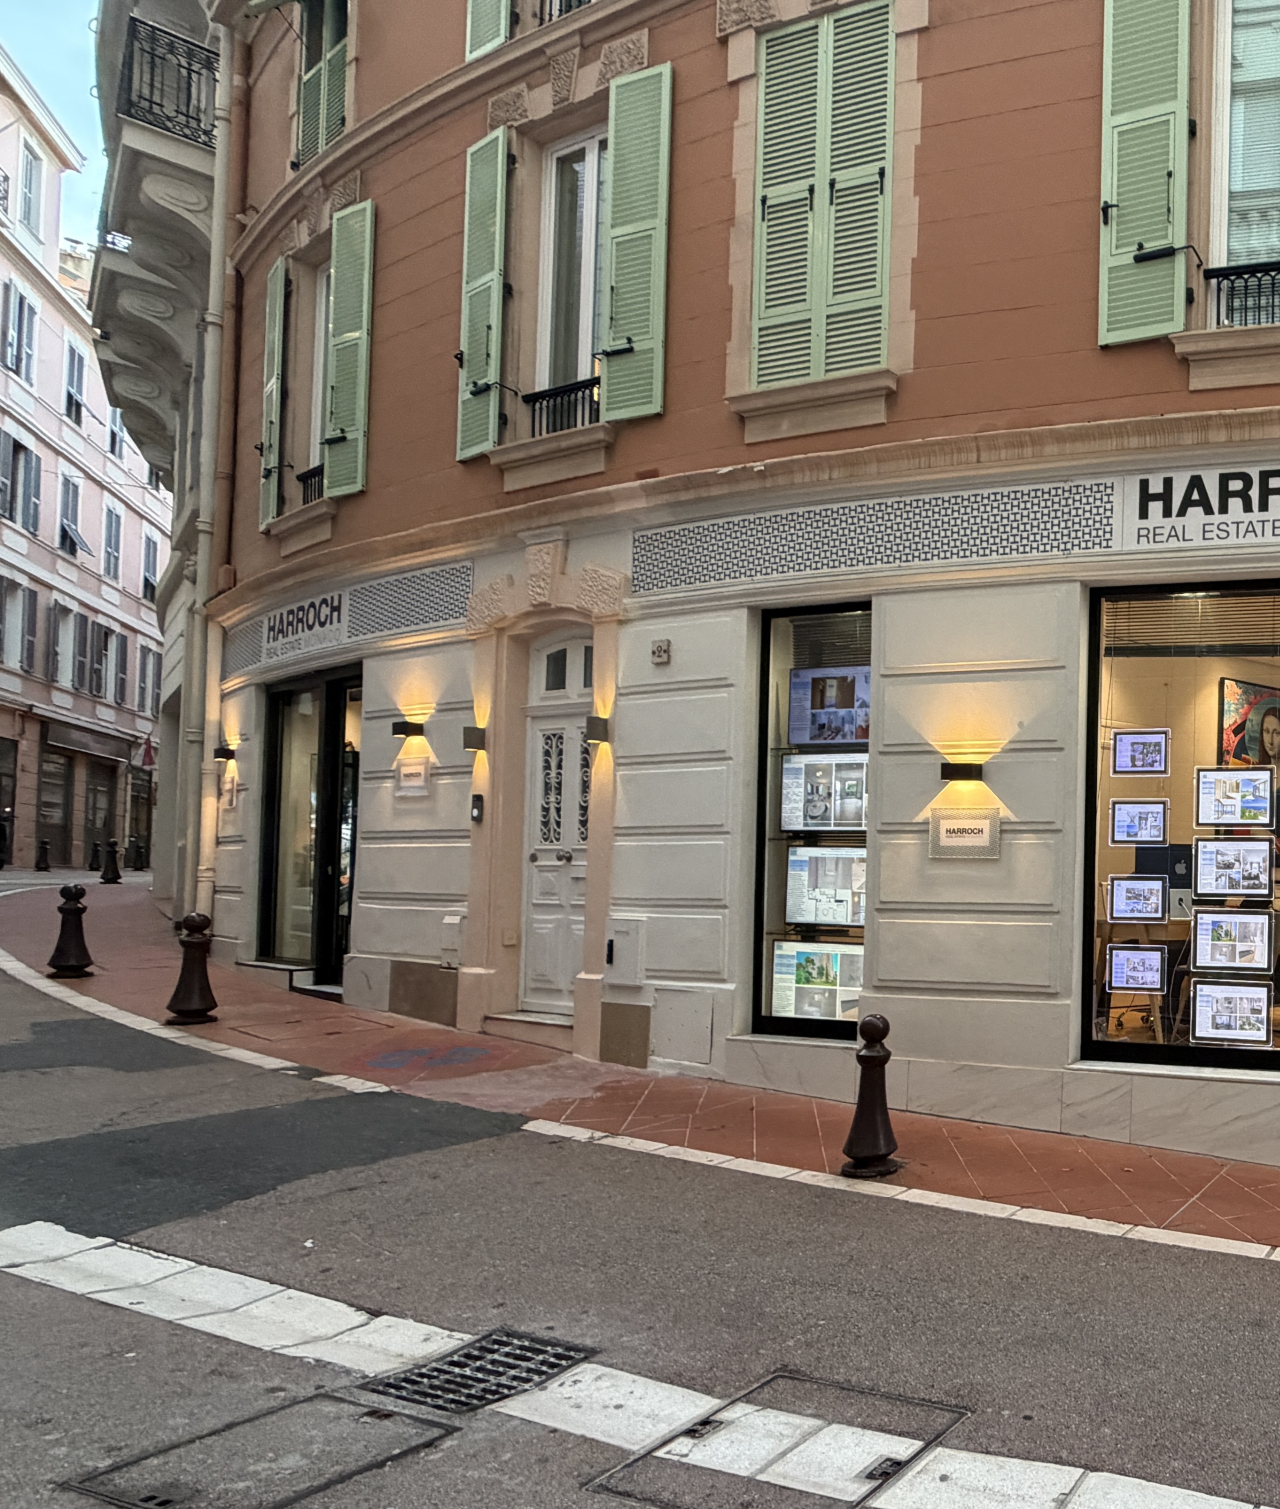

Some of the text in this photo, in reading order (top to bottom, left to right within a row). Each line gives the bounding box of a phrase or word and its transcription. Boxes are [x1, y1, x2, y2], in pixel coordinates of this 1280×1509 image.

[1137, 525, 1194, 545] REAL
[266, 593, 342, 644] HARROCH
[945, 827, 984, 835] HARROCH
